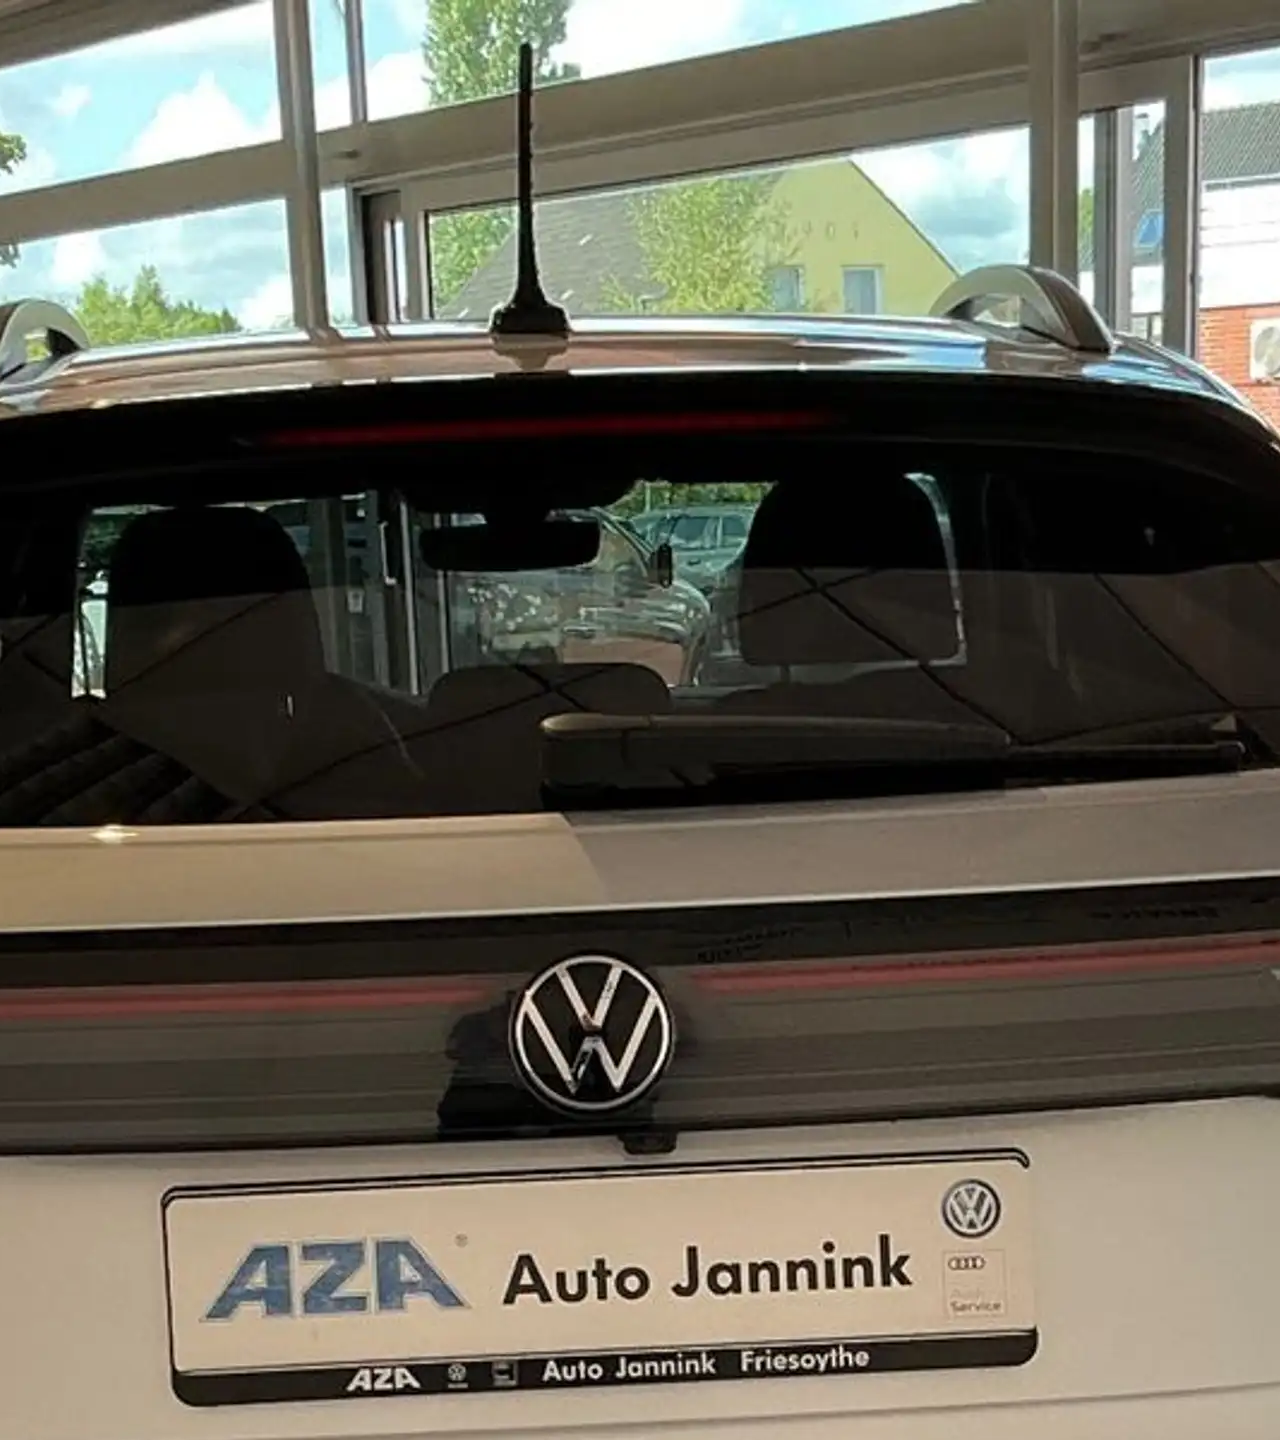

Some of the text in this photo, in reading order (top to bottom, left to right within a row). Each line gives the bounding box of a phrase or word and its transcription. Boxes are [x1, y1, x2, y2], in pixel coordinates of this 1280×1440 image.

[202, 1233, 912, 1320] AZA Auto Jannink
[346, 1366, 420, 1392] AZA
[542, 1343, 870, 1382] Auto Jannink Friesoythe
